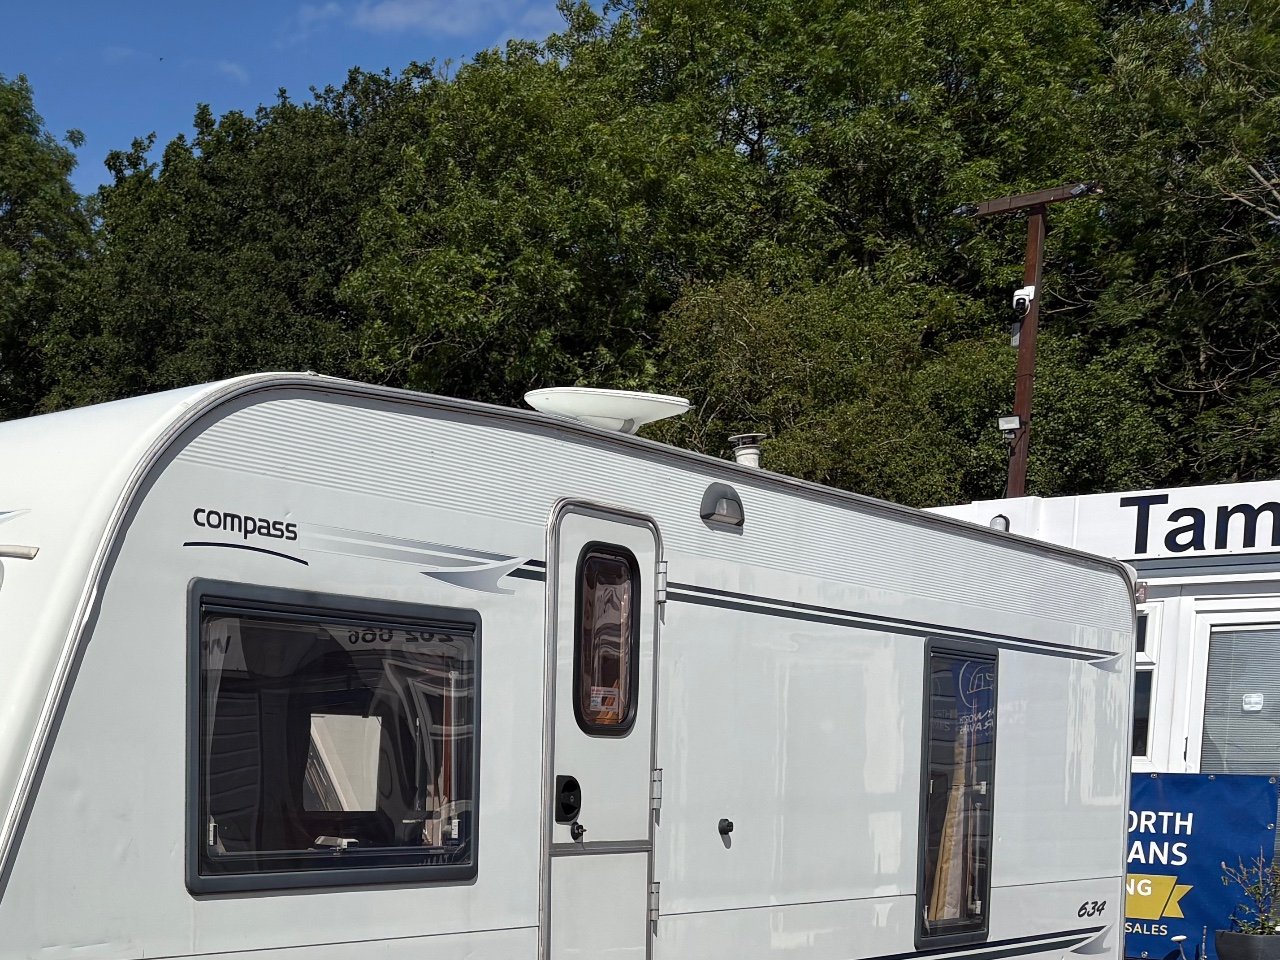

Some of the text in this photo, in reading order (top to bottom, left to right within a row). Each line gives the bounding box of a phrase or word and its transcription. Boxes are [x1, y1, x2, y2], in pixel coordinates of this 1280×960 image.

[193, 508, 298, 541] compass
[1120, 494, 1280, 555] Tam
[1077, 901, 1107, 918] 634
[1125, 922, 1168, 936] SALES
